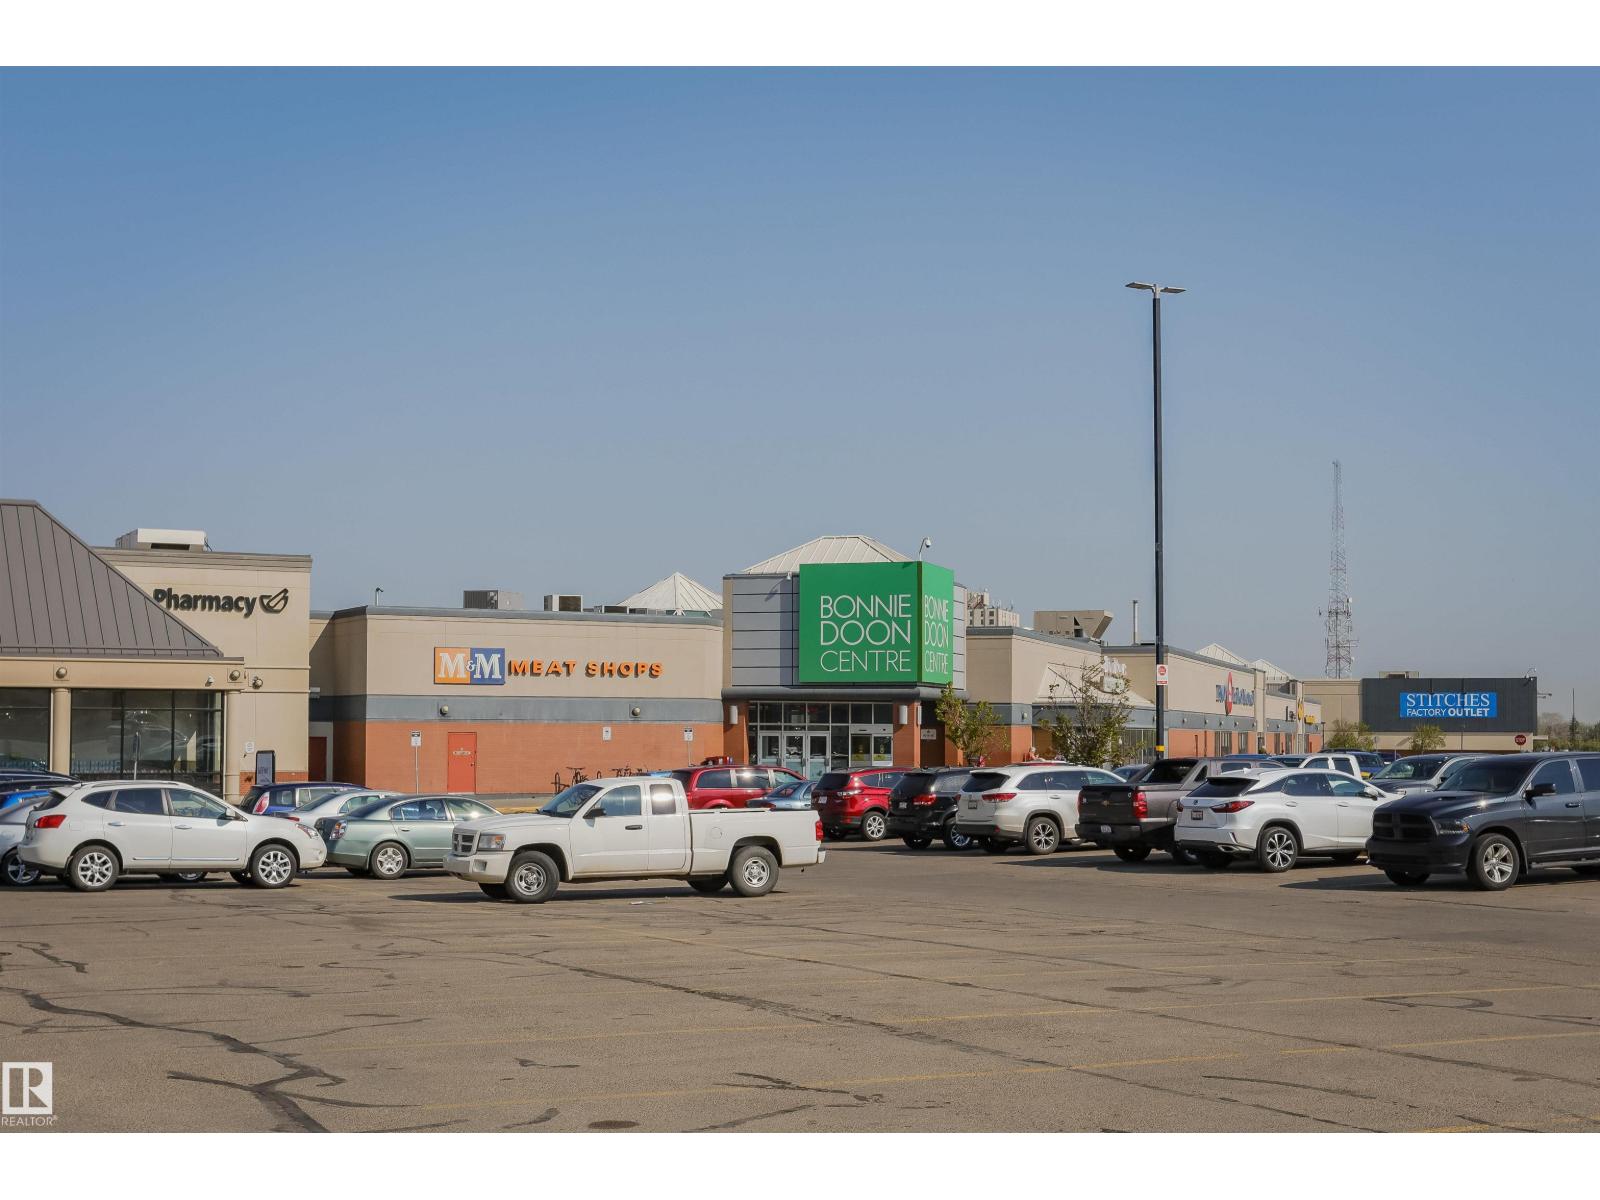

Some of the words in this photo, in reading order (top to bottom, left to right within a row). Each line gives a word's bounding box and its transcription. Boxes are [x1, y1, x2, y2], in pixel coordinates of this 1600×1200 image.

[153, 587, 257, 618] Pharmacy
[820, 594, 912, 619] BONNIE
[924, 594, 949, 623] BONNIE
[820, 619, 911, 646] DOON
[924, 620, 949, 648] DOON
[437, 652, 502, 679] M&M
[508, 659, 577, 677] MEAT
[585, 660, 664, 678] SHOPS
[820, 650, 912, 672] CENTRE
[924, 650, 949, 675] CENTRE
[1406, 693, 1490, 707] STITCHES
[1406, 708, 1446, 717] FACTORY
[1447, 708, 1490, 717] OUTLET
